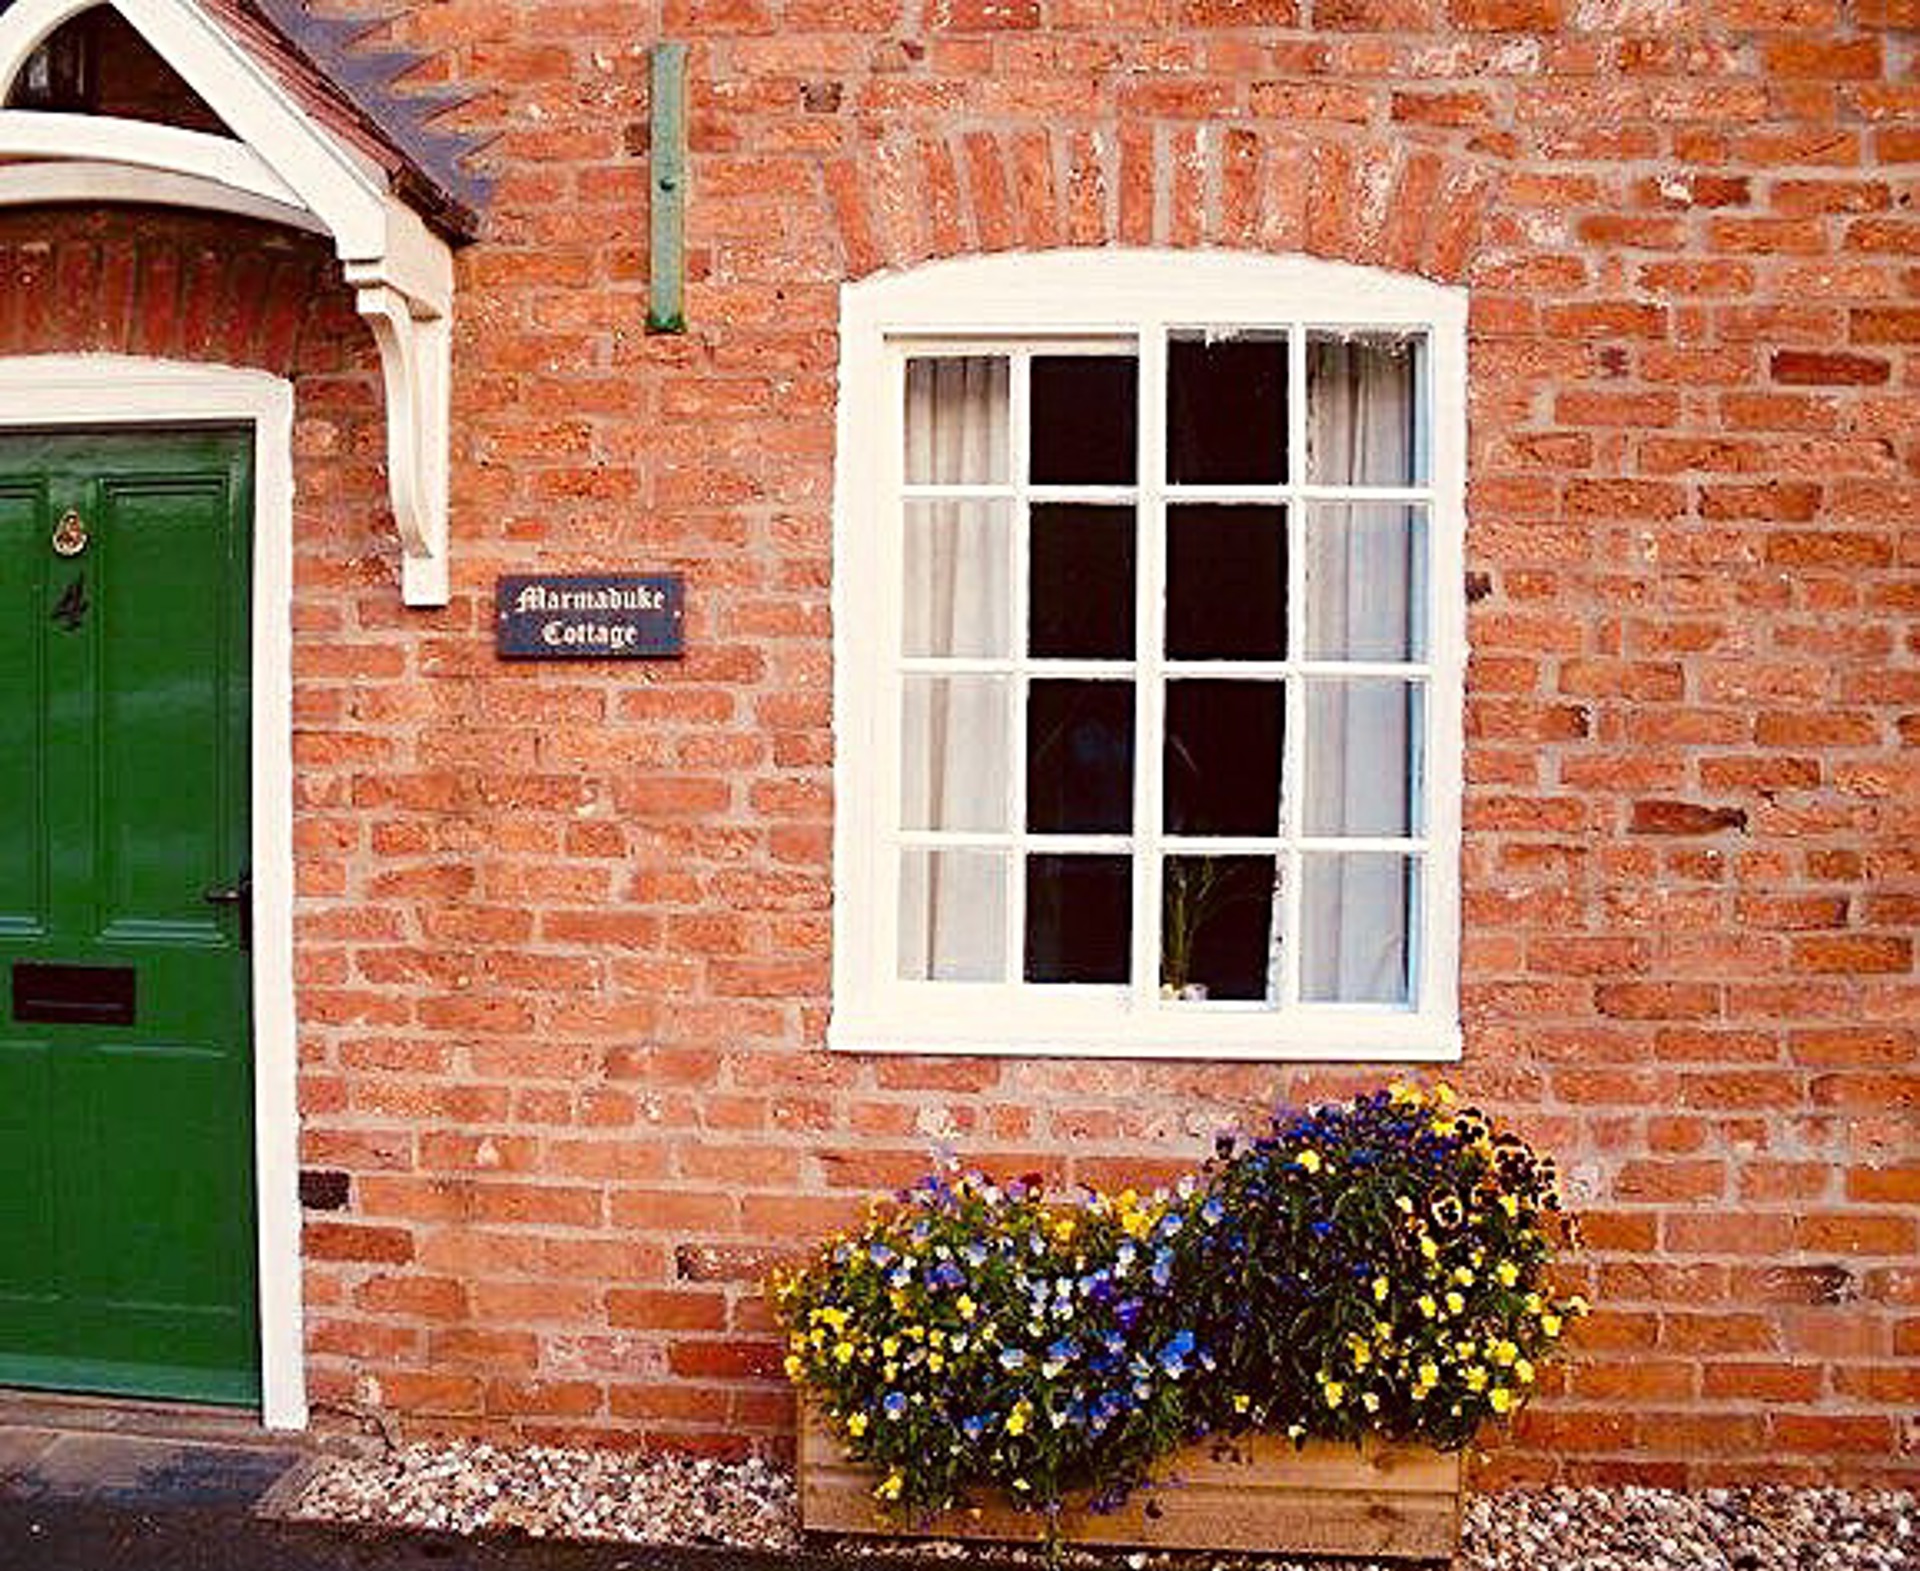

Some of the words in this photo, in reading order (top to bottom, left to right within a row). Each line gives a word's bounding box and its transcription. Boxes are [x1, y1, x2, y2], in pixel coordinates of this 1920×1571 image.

[51, 572, 89, 631] 4
[515, 585, 665, 612] Marmaduke
[542, 620, 638, 648] Cottage
